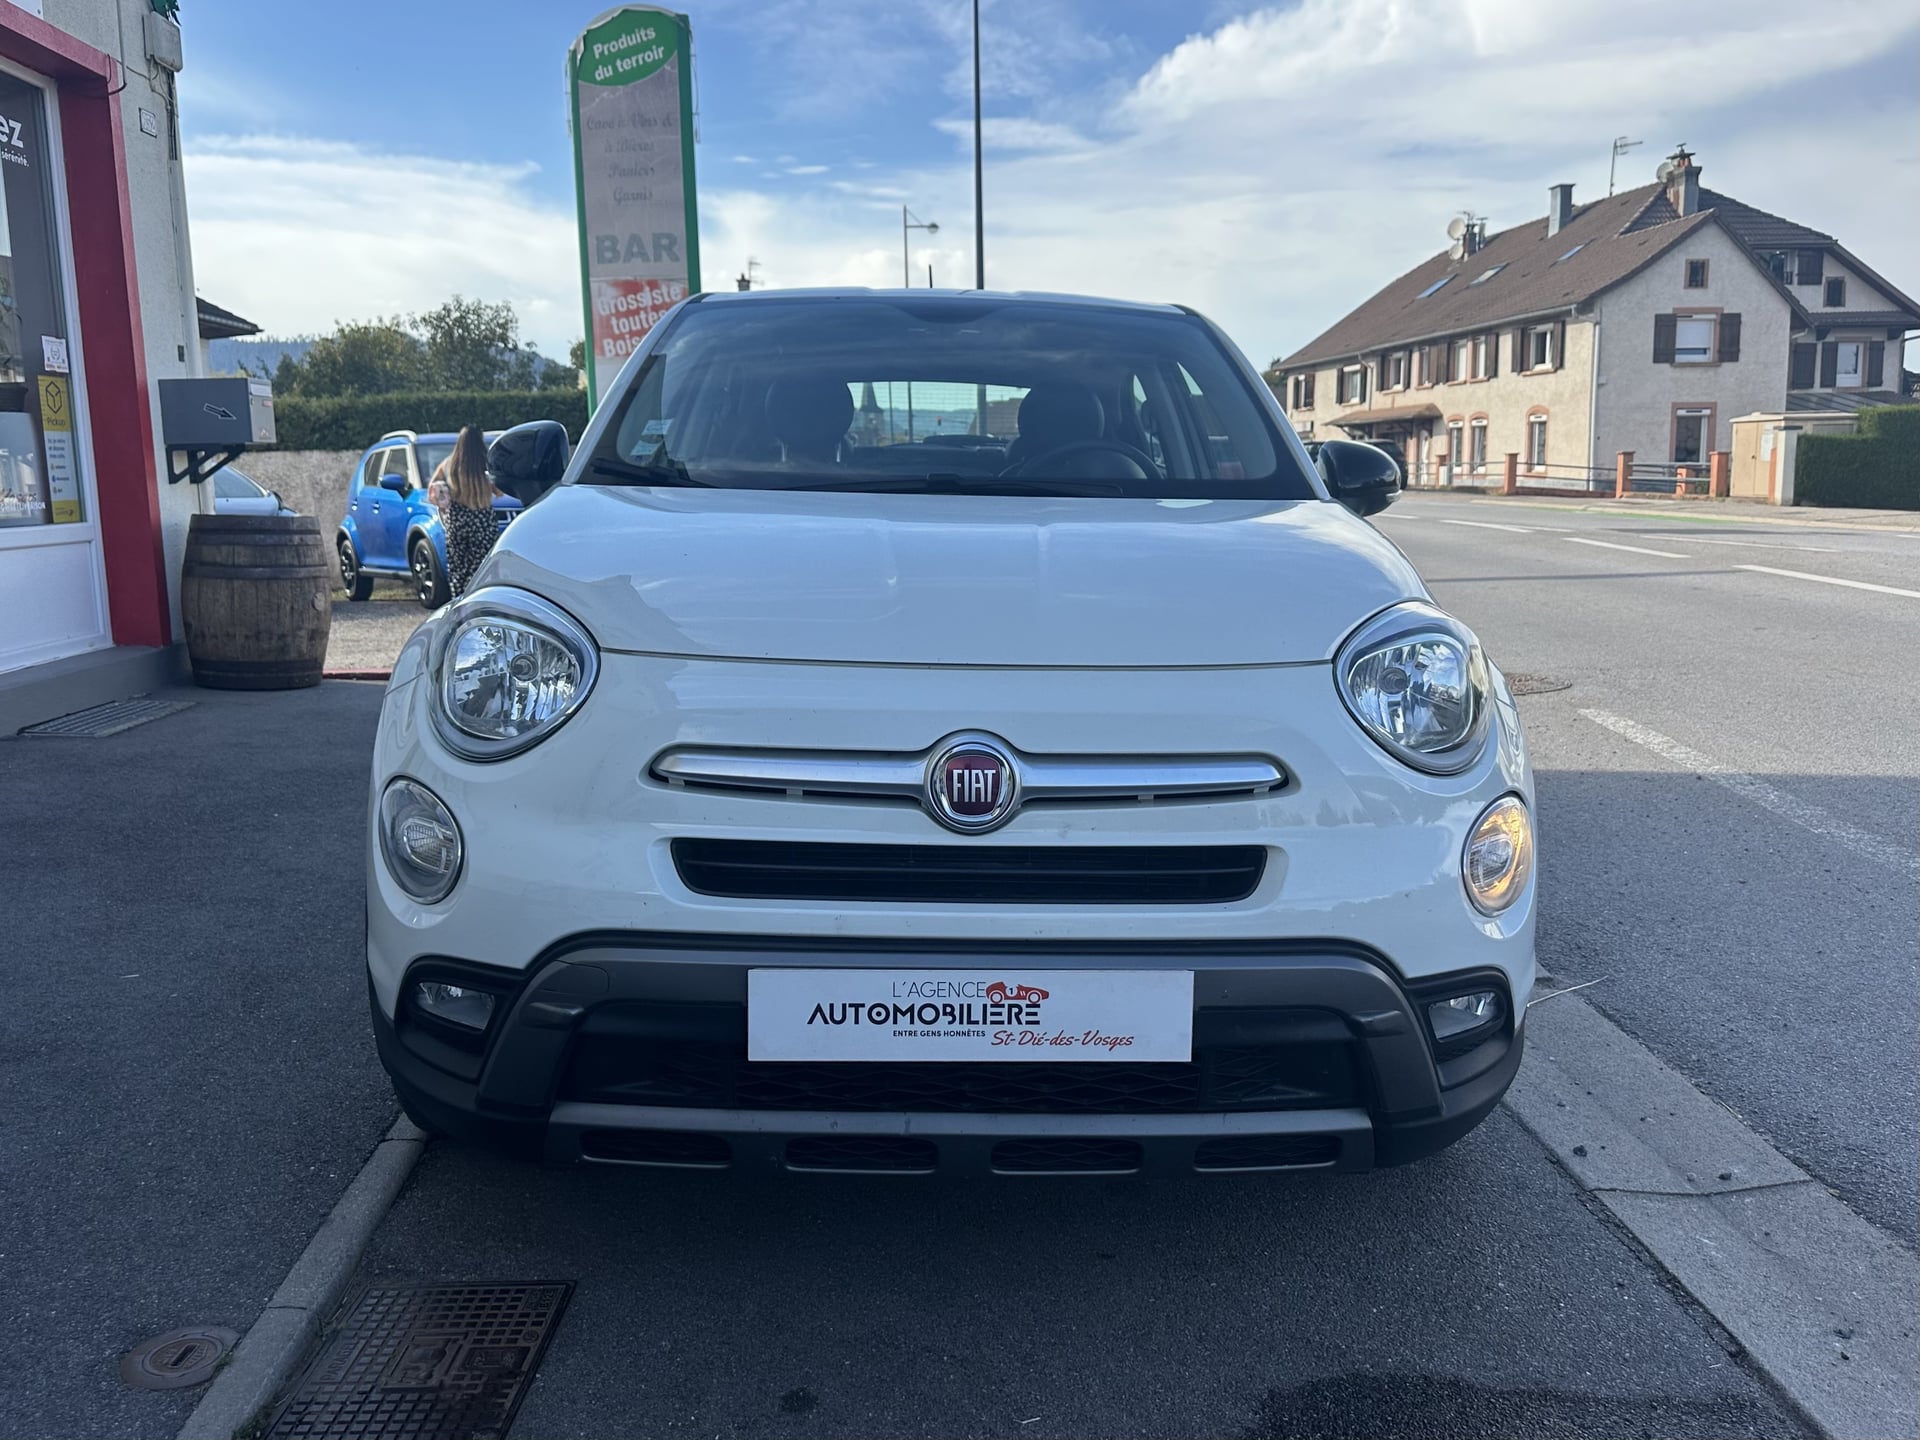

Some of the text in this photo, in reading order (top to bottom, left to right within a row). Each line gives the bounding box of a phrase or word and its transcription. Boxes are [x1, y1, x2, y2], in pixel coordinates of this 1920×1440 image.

[592, 26, 657, 60] Produits
[594, 44, 665, 81] du terroir
[595, 232, 681, 265] BAR
[597, 281, 683, 317] Grossiste
[952, 769, 996, 803] FIAT
[892, 981, 987, 998] L'AGENCE
[892, 1027, 986, 1038] ENTRE GENS HONNÊTES
[990, 1029, 1135, 1052] St-Dié-des-Vosges
